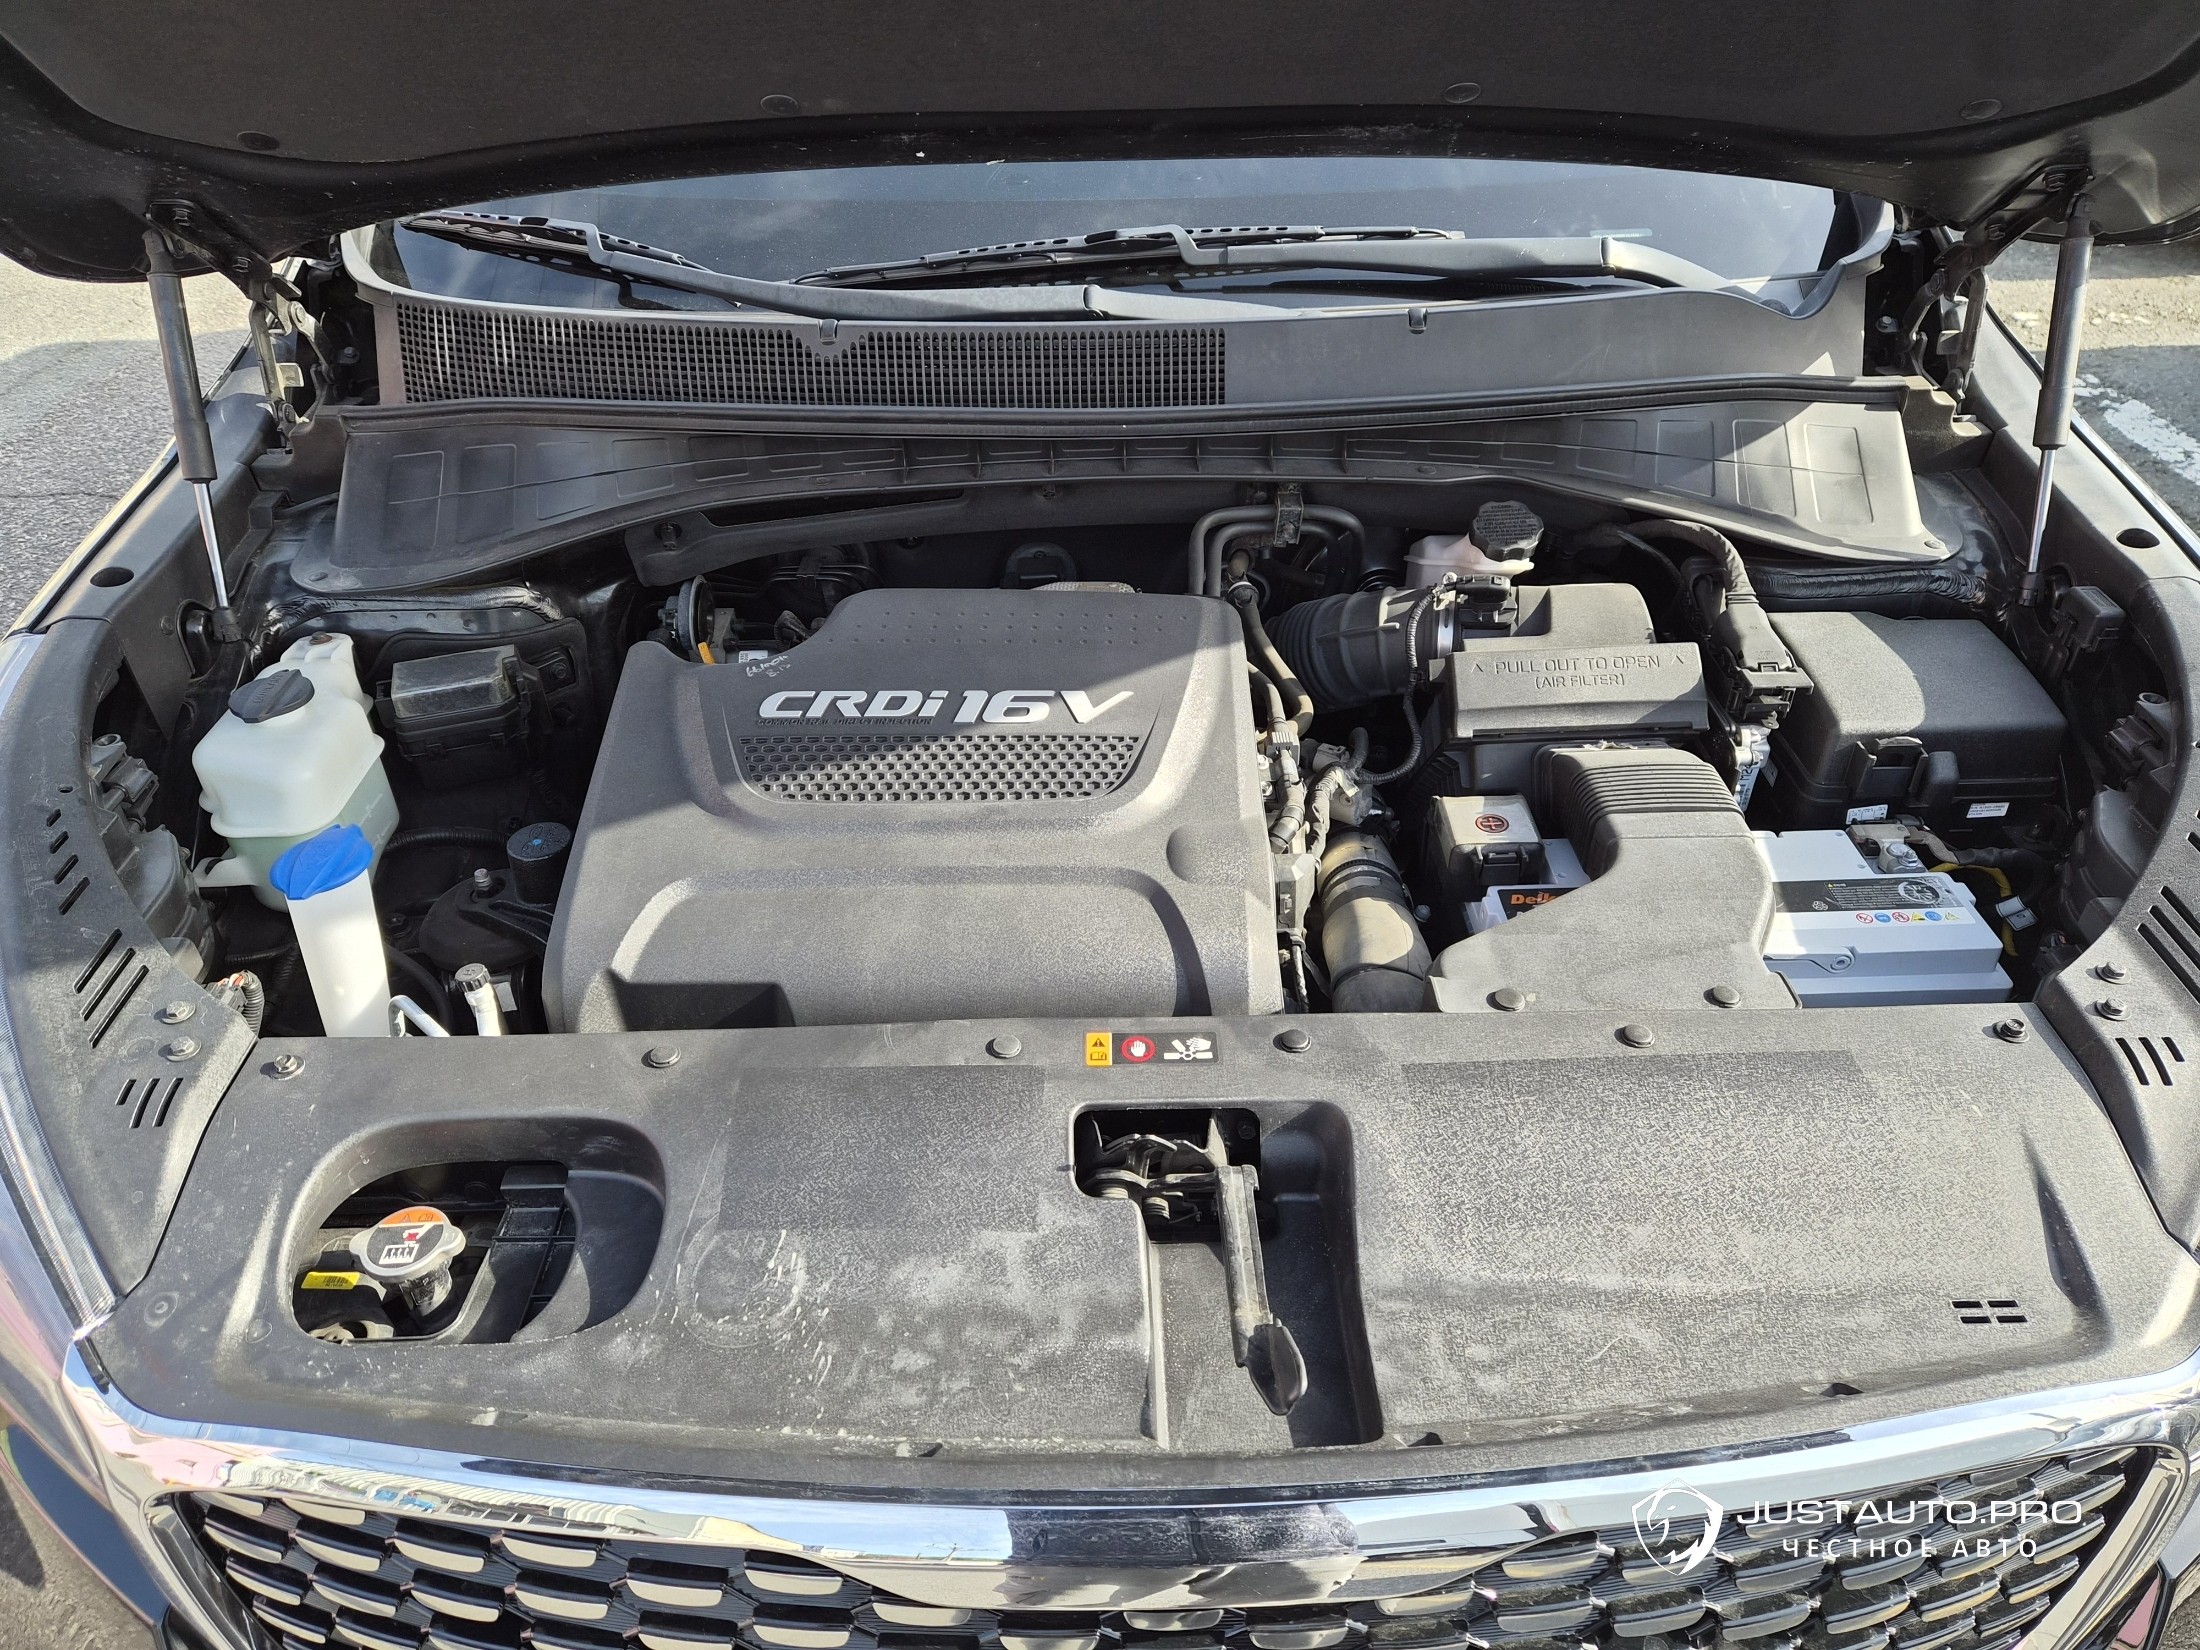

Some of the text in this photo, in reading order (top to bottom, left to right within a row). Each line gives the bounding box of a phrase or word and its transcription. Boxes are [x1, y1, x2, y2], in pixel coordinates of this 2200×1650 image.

[1495, 655, 1660, 674] PULL OUT TO OPEN
[1535, 673, 1625, 689] (AIR FILTER)
[759, 690, 1134, 724] CRDi 16V
[757, 718, 806, 726] COMMON
